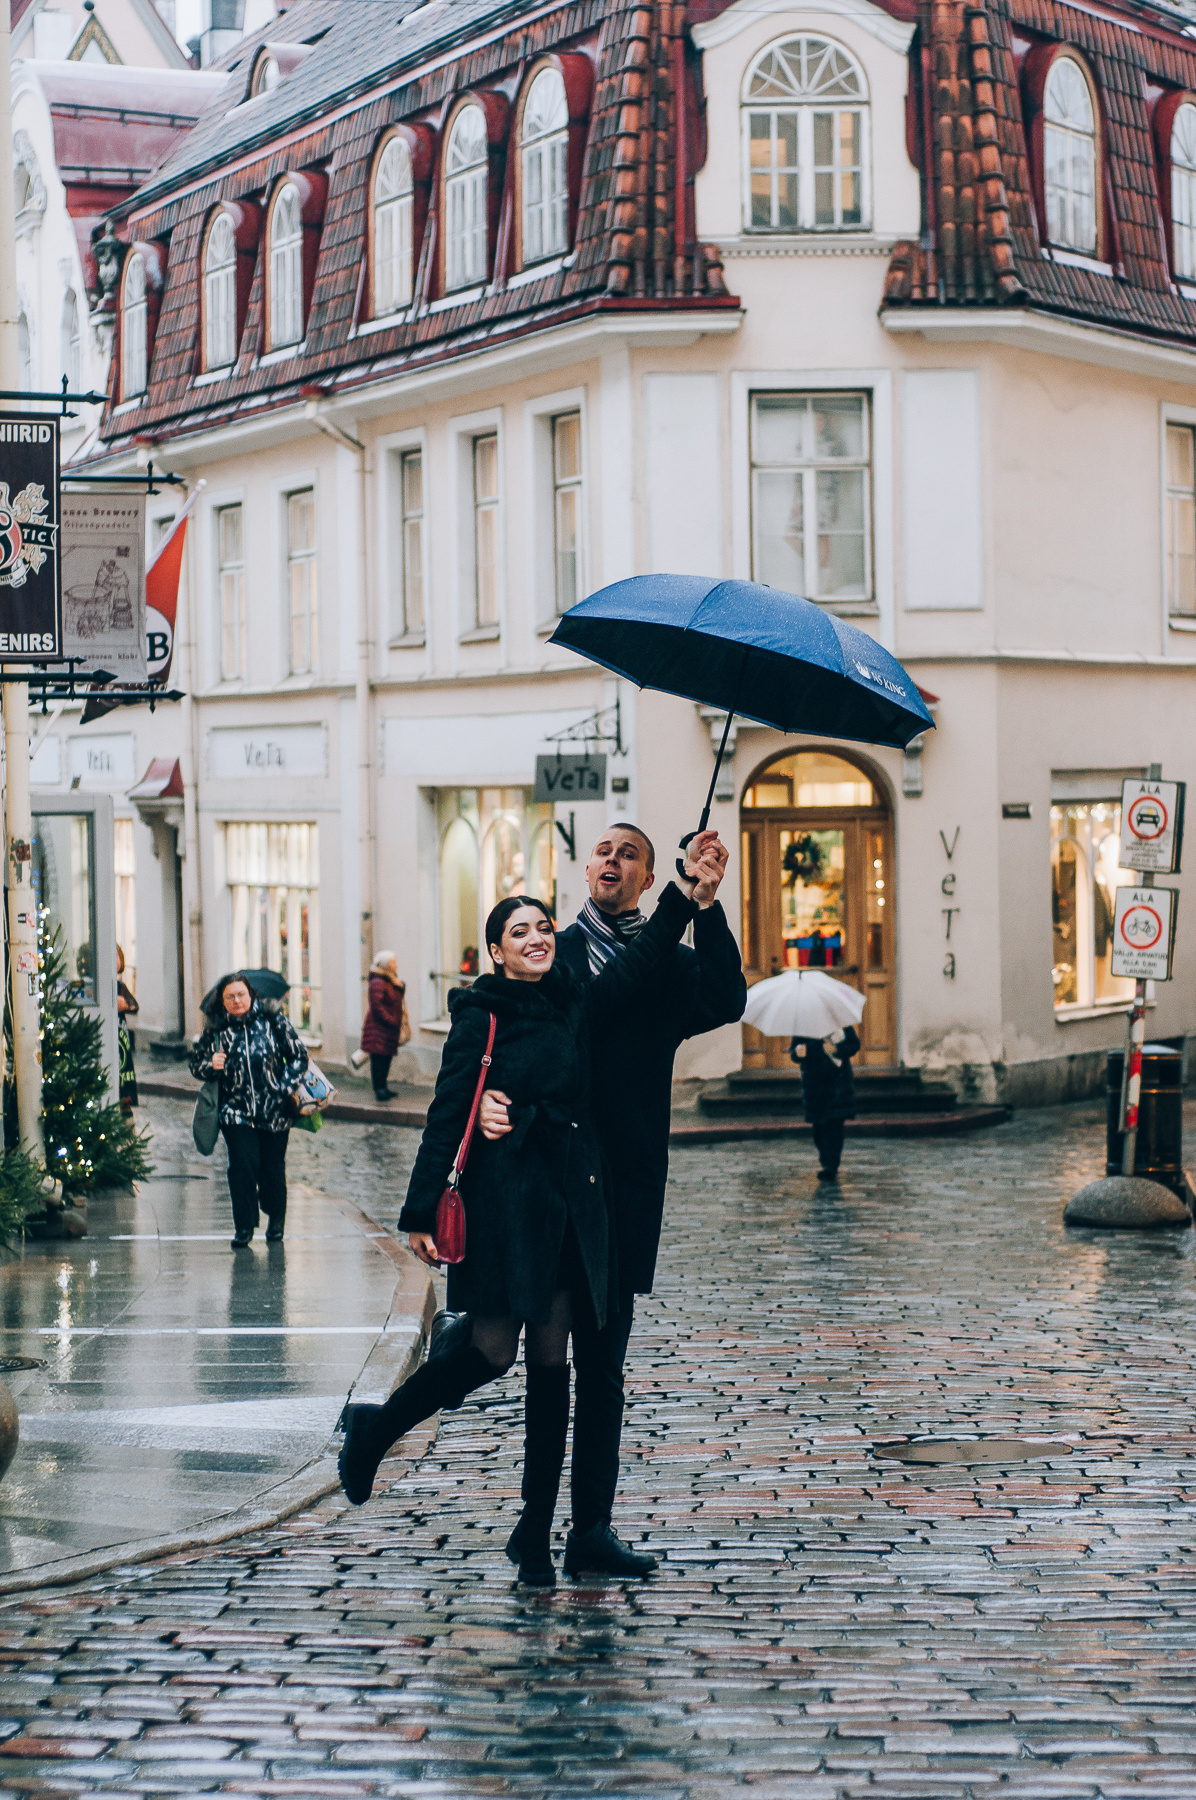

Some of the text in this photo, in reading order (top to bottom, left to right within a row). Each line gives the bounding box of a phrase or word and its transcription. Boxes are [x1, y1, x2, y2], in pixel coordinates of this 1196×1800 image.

[93, 507, 139, 517] Brewery
[22, 528, 47, 542] TIC
[0, 633, 54, 651] ENIRS
[883, 678, 906, 697] KING
[544, 766, 599, 791] VeTa
[1139, 784, 1161, 795] ALA
[1132, 892, 1154, 903] ALA
